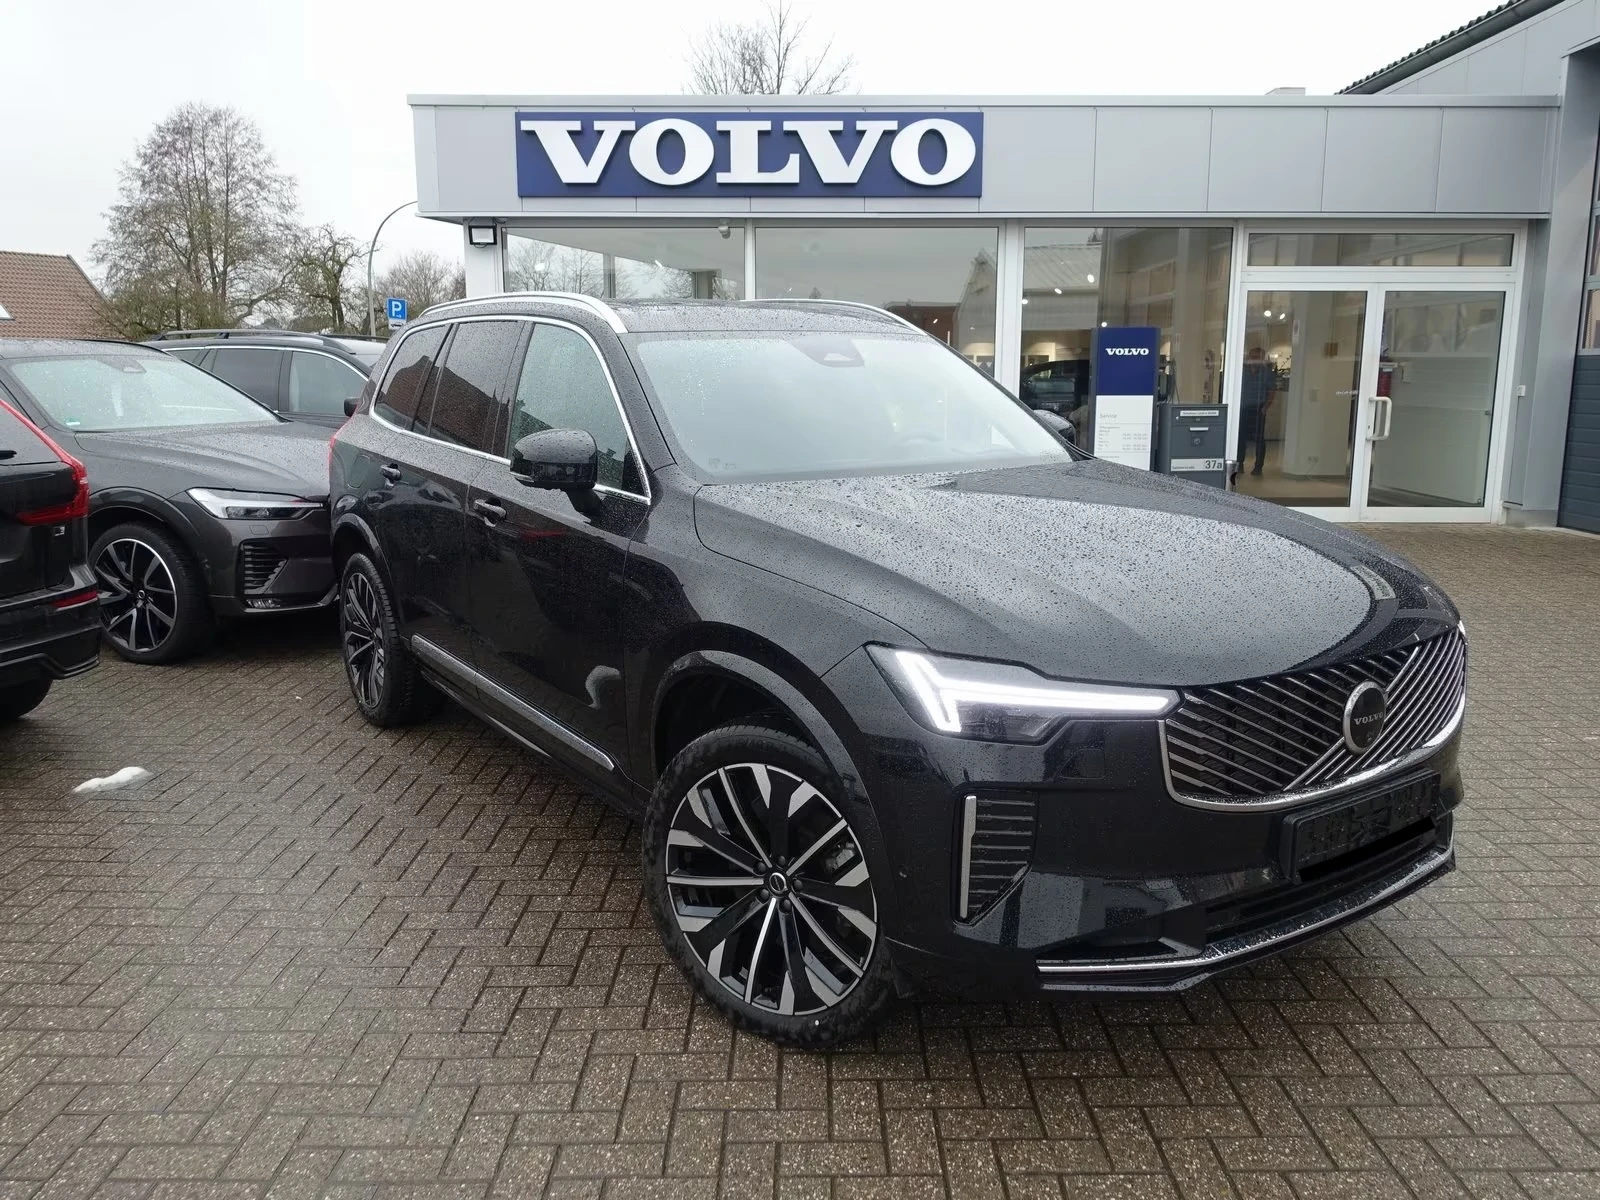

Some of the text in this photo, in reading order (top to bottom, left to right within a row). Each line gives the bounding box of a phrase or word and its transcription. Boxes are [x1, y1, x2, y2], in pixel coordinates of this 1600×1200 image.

[520, 118, 976, 186] VOLVO
[392, 301, 402, 317] P
[1105, 348, 1149, 356] VOLVO
[1205, 460, 1222, 469] 37a
[1354, 712, 1383, 725] VOLVO
